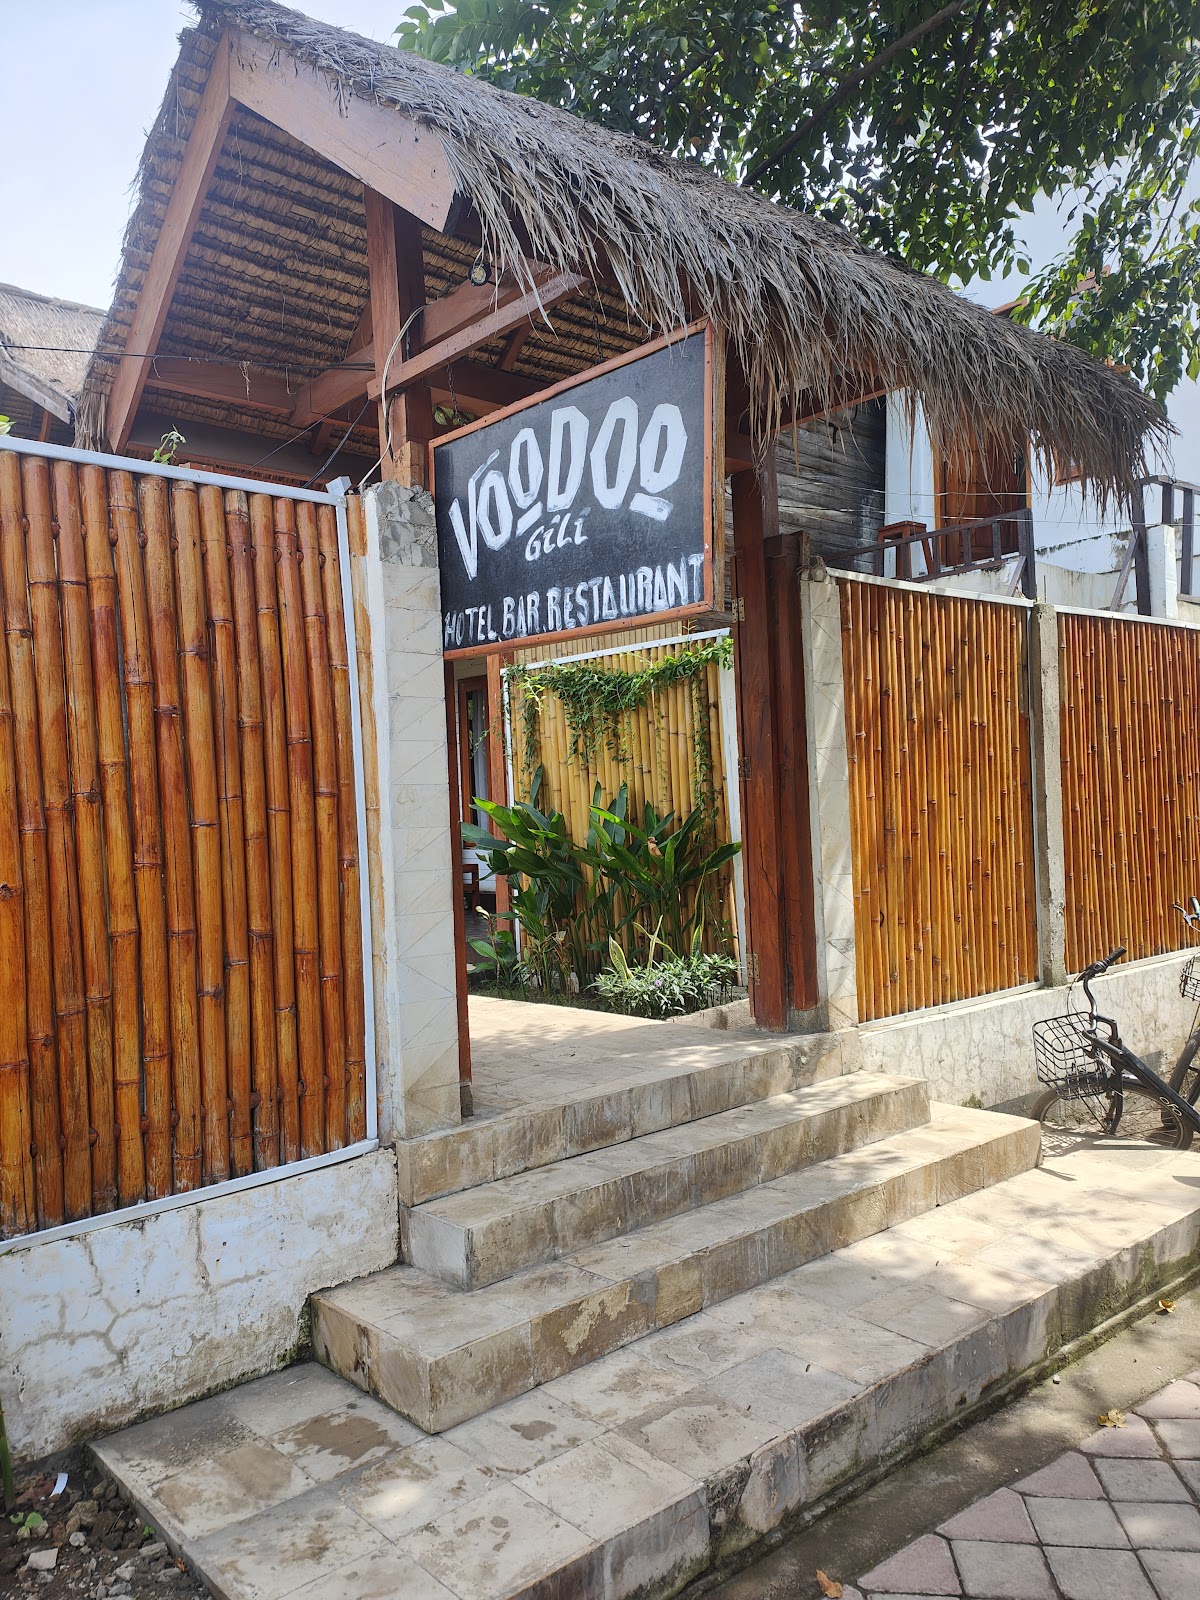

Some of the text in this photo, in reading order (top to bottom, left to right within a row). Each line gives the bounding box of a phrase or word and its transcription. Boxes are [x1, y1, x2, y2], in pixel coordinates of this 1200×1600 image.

[449, 396, 688, 581] VOODOO
[546, 553, 704, 632] RESTAURANT
[1159, 1096, 1182, 1117] ofo
